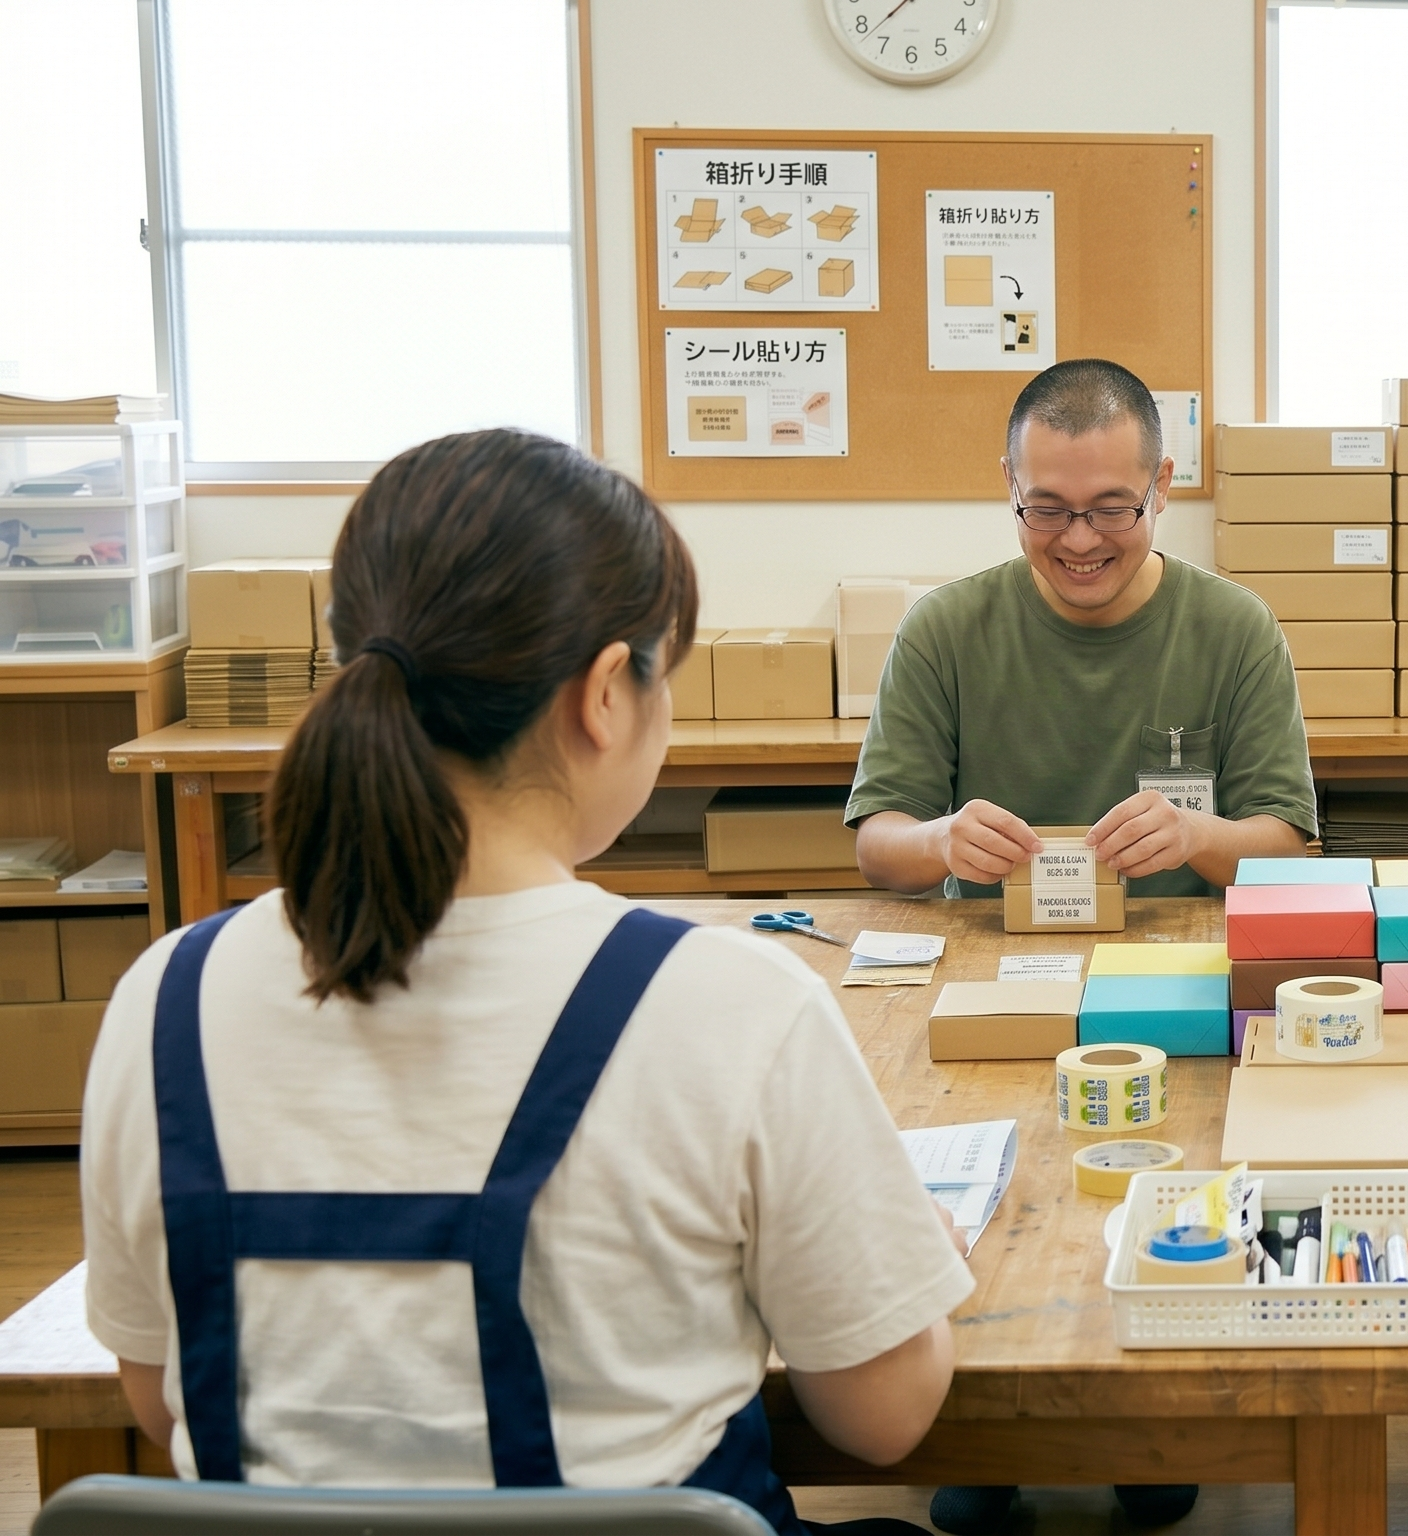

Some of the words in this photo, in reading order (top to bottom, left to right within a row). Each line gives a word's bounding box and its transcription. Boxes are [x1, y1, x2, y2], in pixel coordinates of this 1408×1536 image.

[855, 15, 868, 34] 8
[954, 17, 967, 36] 4
[877, 36, 890, 55] 7
[905, 45, 918, 64] 6
[934, 38, 947, 56] 5
[705, 160, 828, 186] 箱折り手順
[685, 339, 827, 363] シール貼り方
